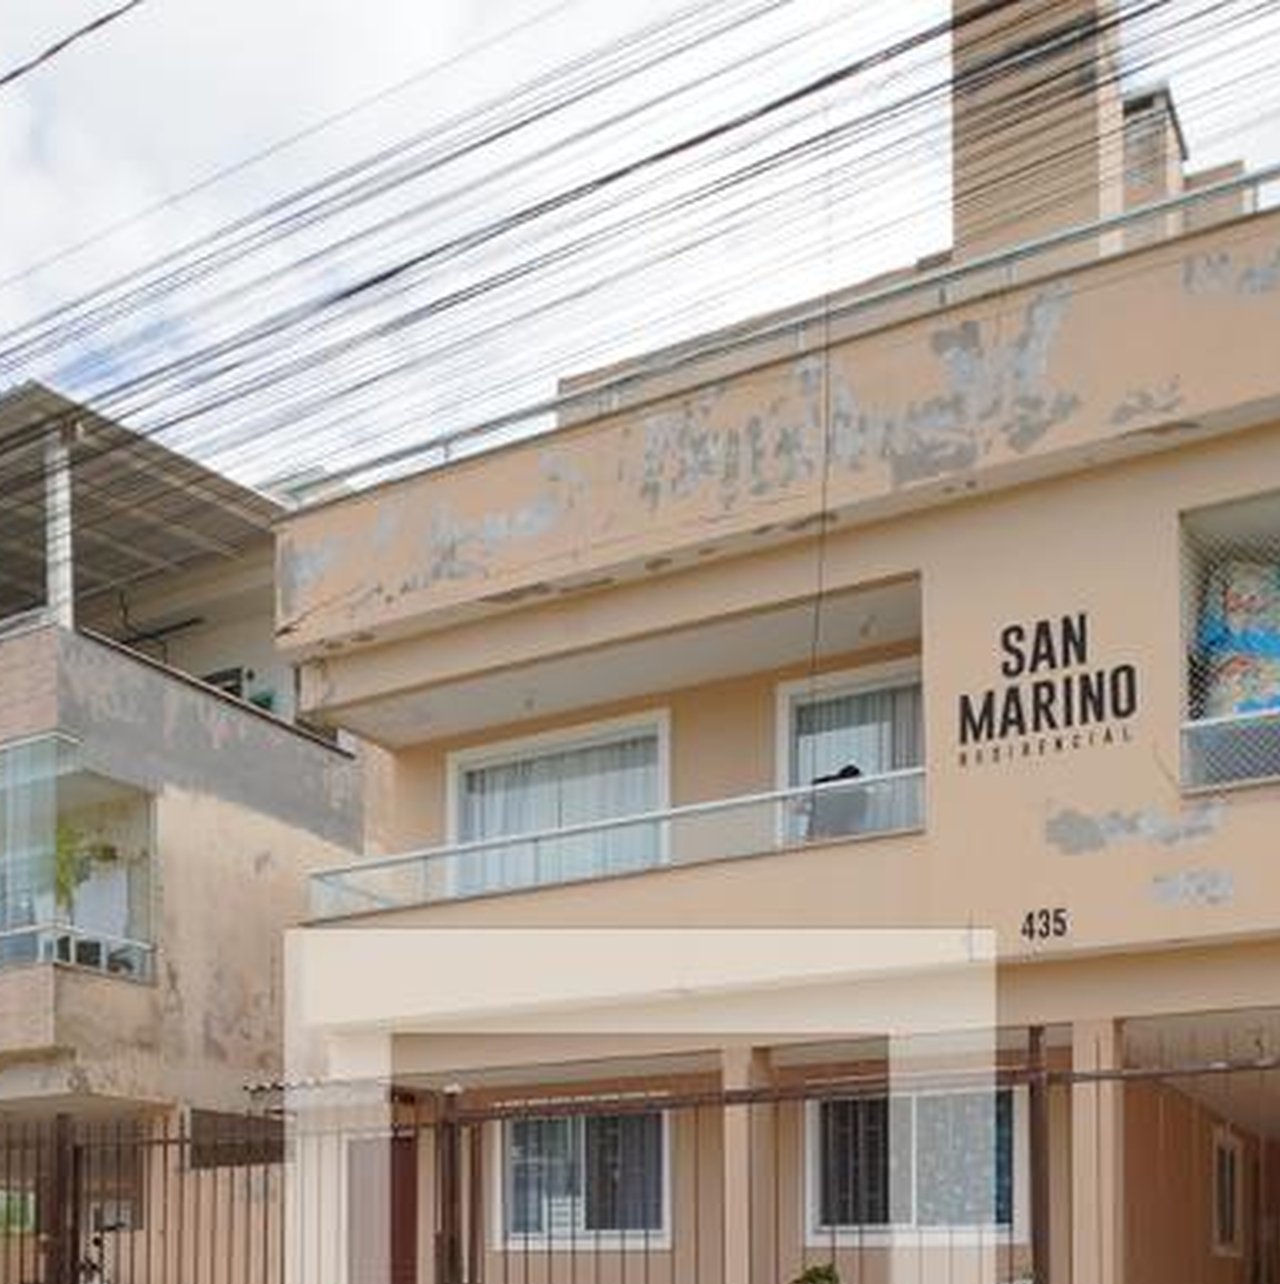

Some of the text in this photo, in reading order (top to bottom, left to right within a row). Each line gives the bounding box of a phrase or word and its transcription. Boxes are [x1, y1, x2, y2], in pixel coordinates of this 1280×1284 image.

[1001, 613, 1088, 679] SAN
[959, 664, 1138, 745] MARINO
[959, 726, 1132, 767] RESIDENCIAL
[1021, 908, 1068, 941] 435
